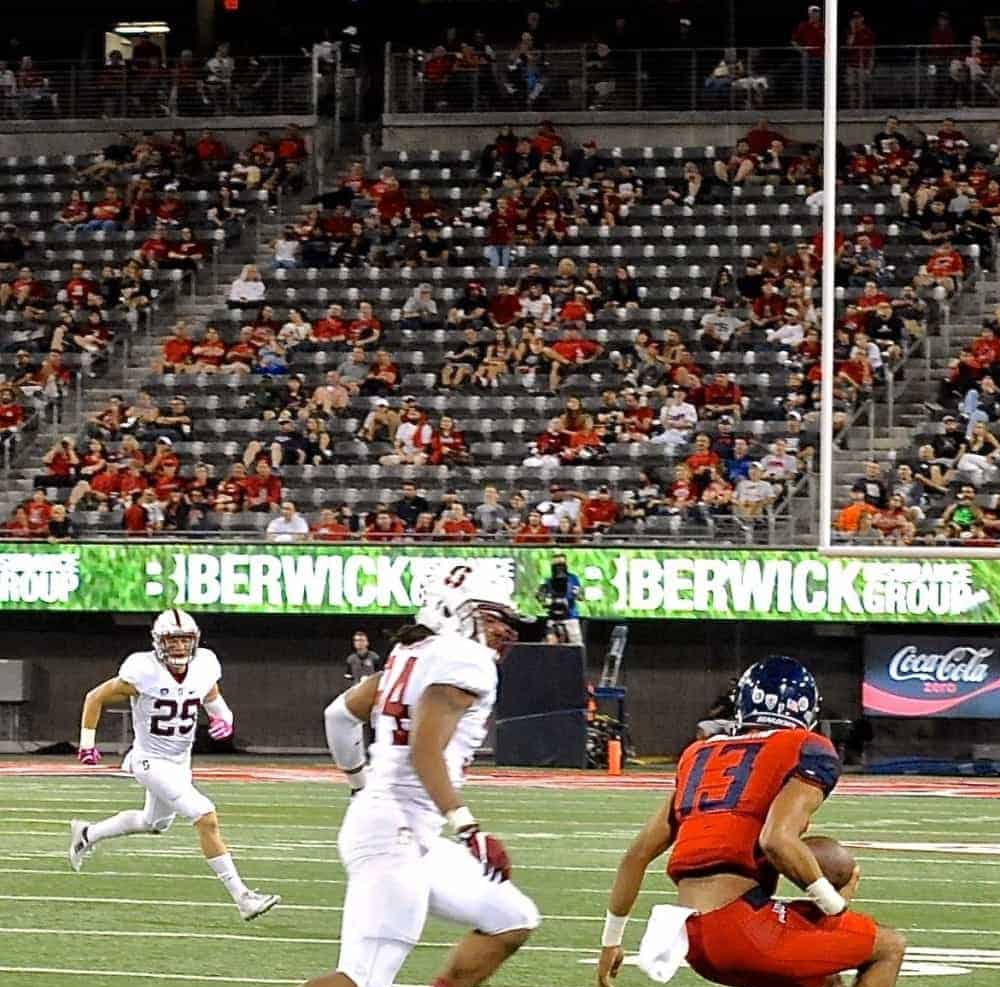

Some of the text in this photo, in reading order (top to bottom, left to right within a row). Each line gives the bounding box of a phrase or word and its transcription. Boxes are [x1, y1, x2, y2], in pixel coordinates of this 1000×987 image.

[187, 553, 411, 607] BERWICK
[629, 558, 866, 614] BERWICK
[864, 580, 975, 615] GROUP
[150, 698, 200, 737] 29
[678, 743, 762, 815] 13
